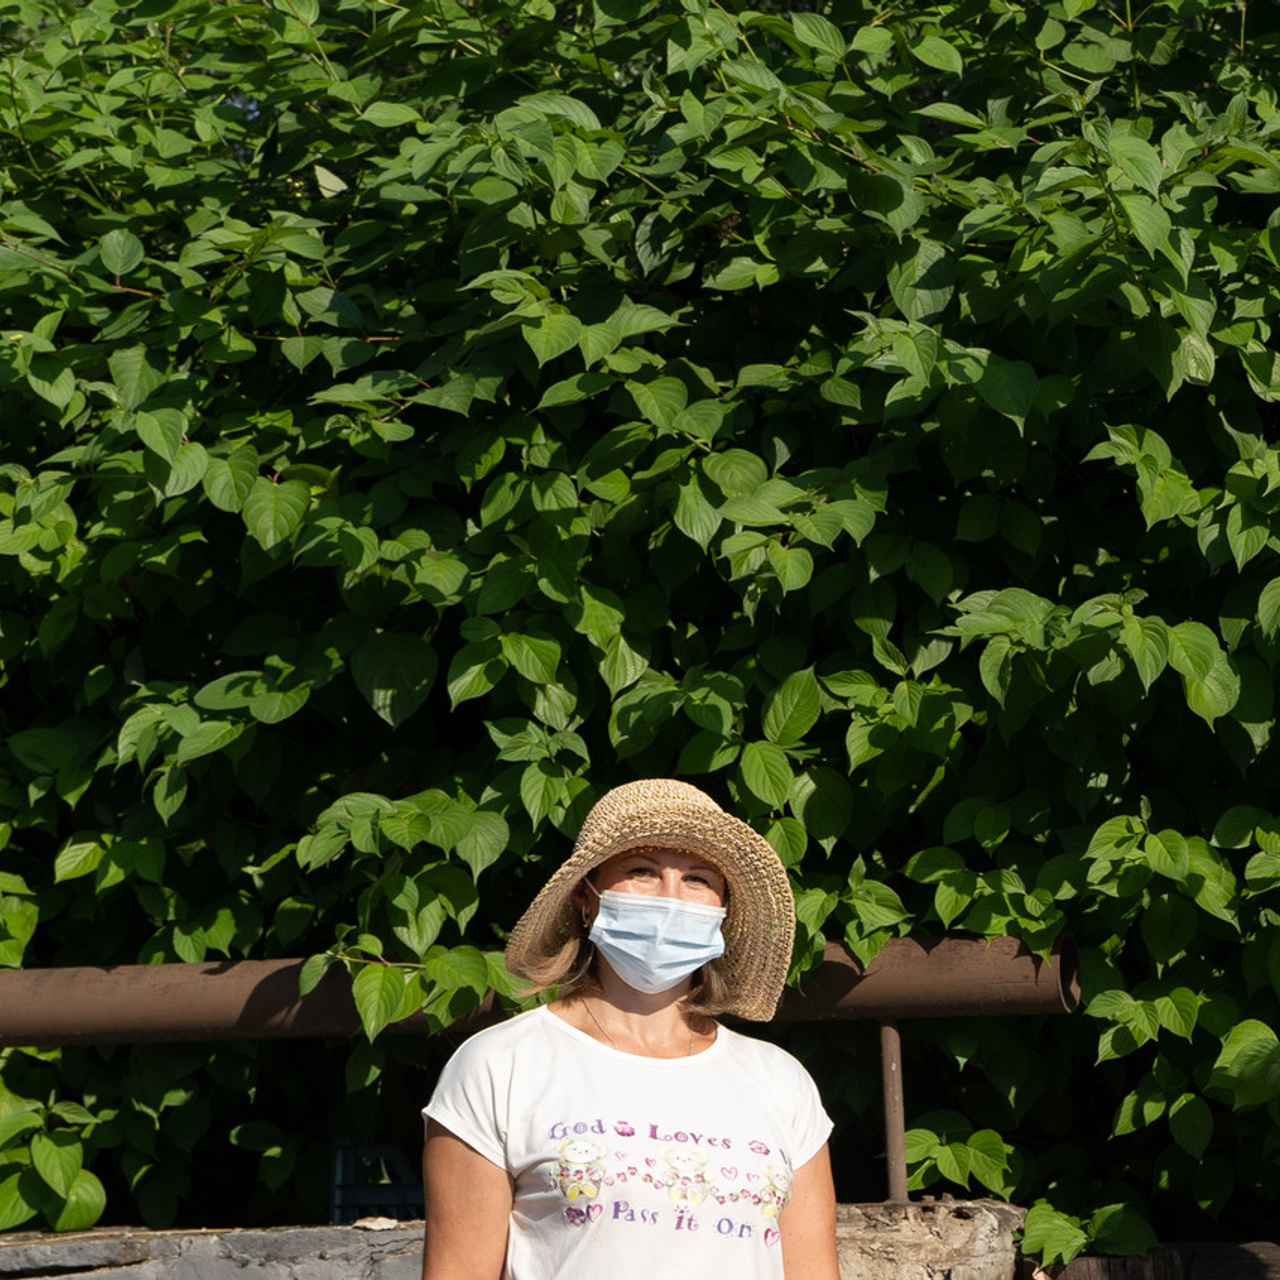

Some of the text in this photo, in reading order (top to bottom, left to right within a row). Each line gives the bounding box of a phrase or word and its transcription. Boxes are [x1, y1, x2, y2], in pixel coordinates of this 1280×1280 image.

[550, 1118, 732, 1150] God Loves
[612, 1200, 752, 1238] Pass it On
